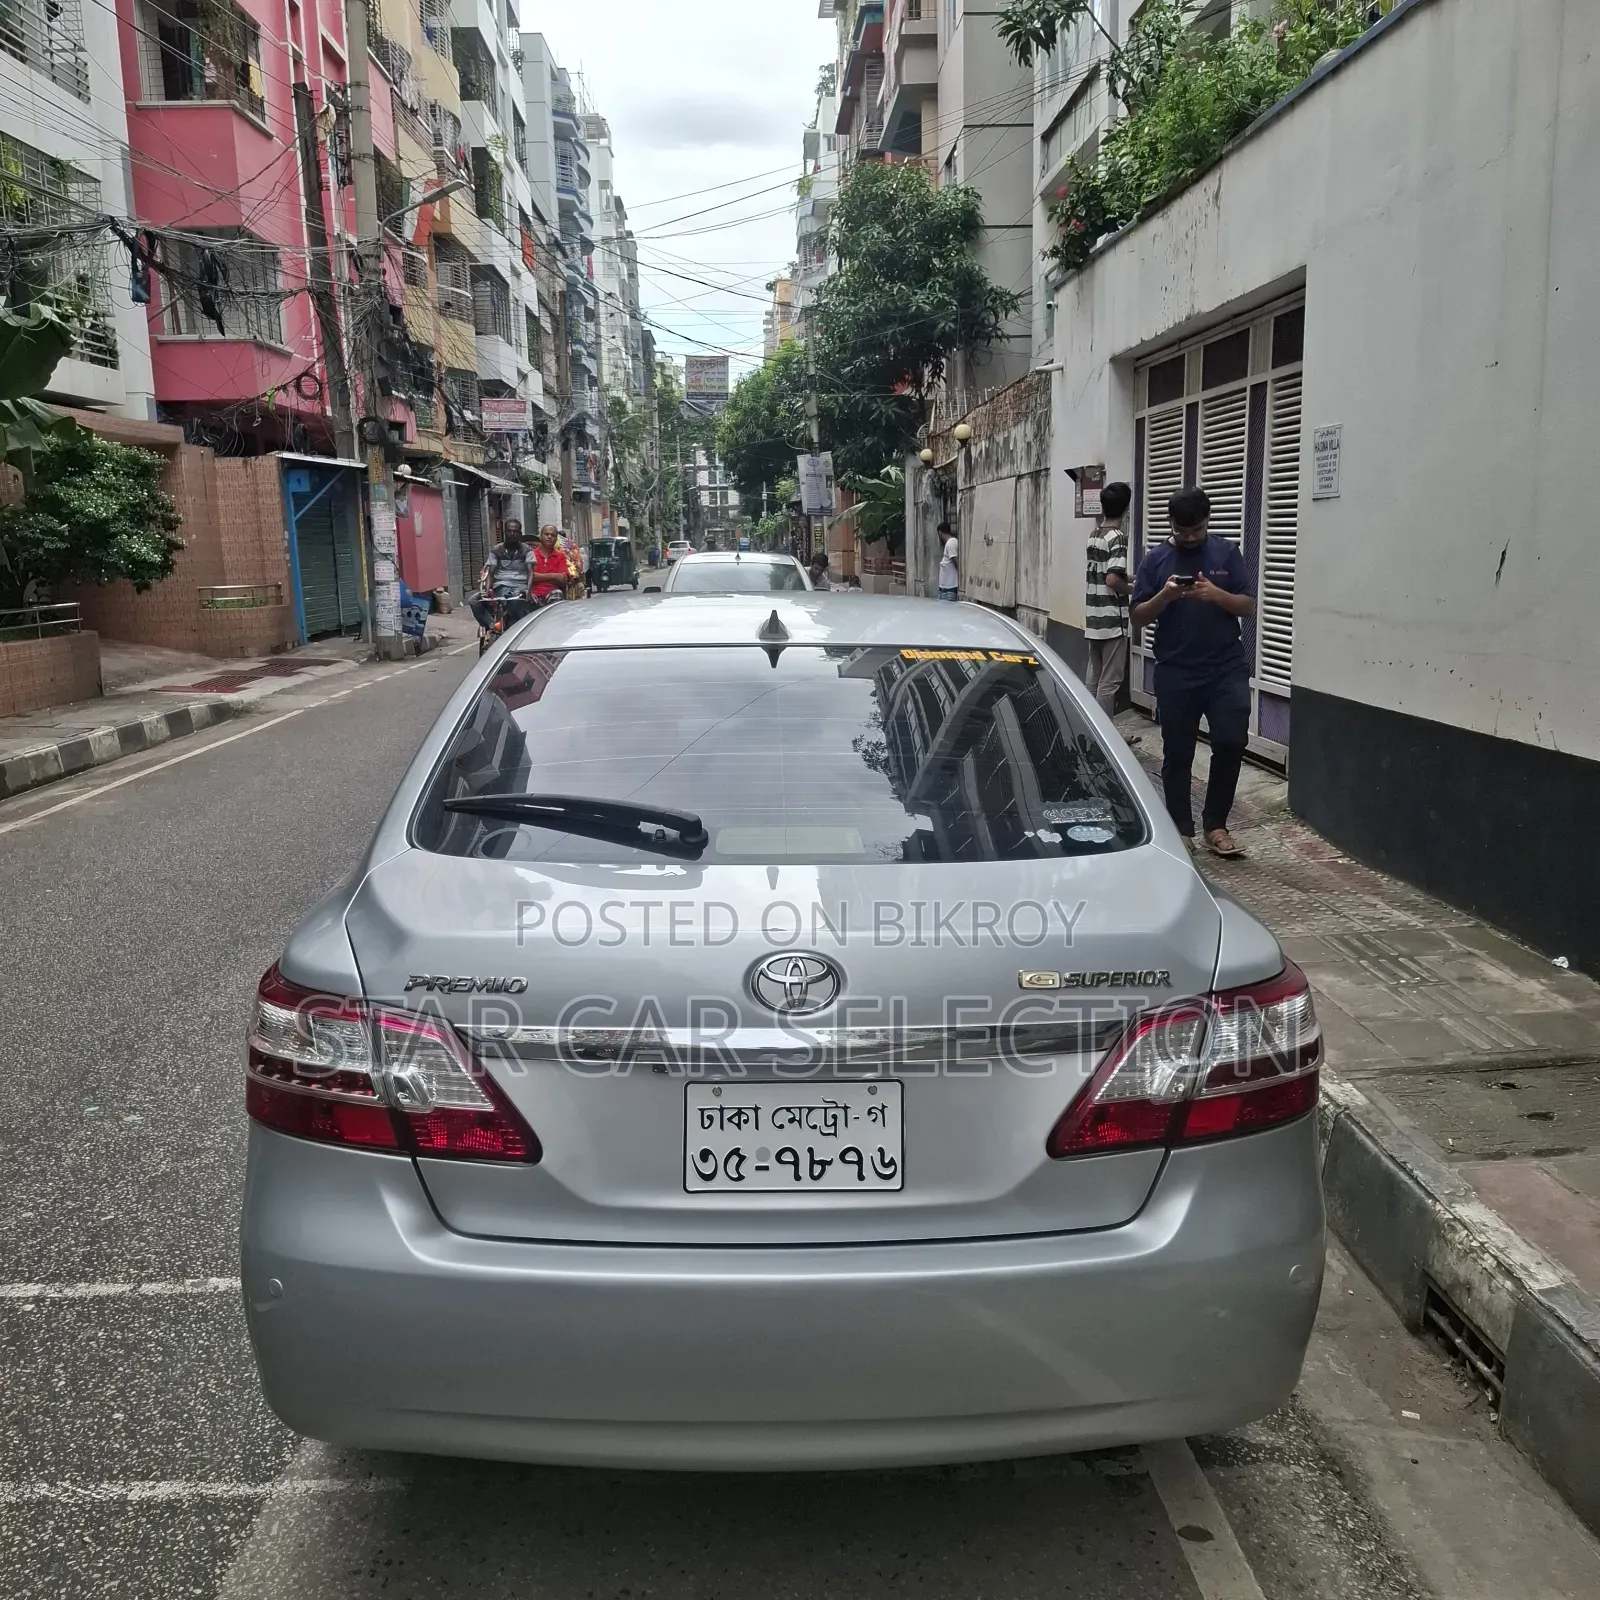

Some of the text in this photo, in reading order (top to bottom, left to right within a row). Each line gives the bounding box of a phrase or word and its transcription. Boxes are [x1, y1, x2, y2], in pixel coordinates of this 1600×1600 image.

[1329, 439, 1340, 450] VILLA
[900, 649, 1040, 665] Diamond Carz
[403, 973, 529, 995] PREMIO
[1063, 969, 1173, 988] SUPERIOR
[697, 1103, 762, 1132] ঢাকা
[691, 1145, 898, 1183] ৩৫-৭৮৭৬
